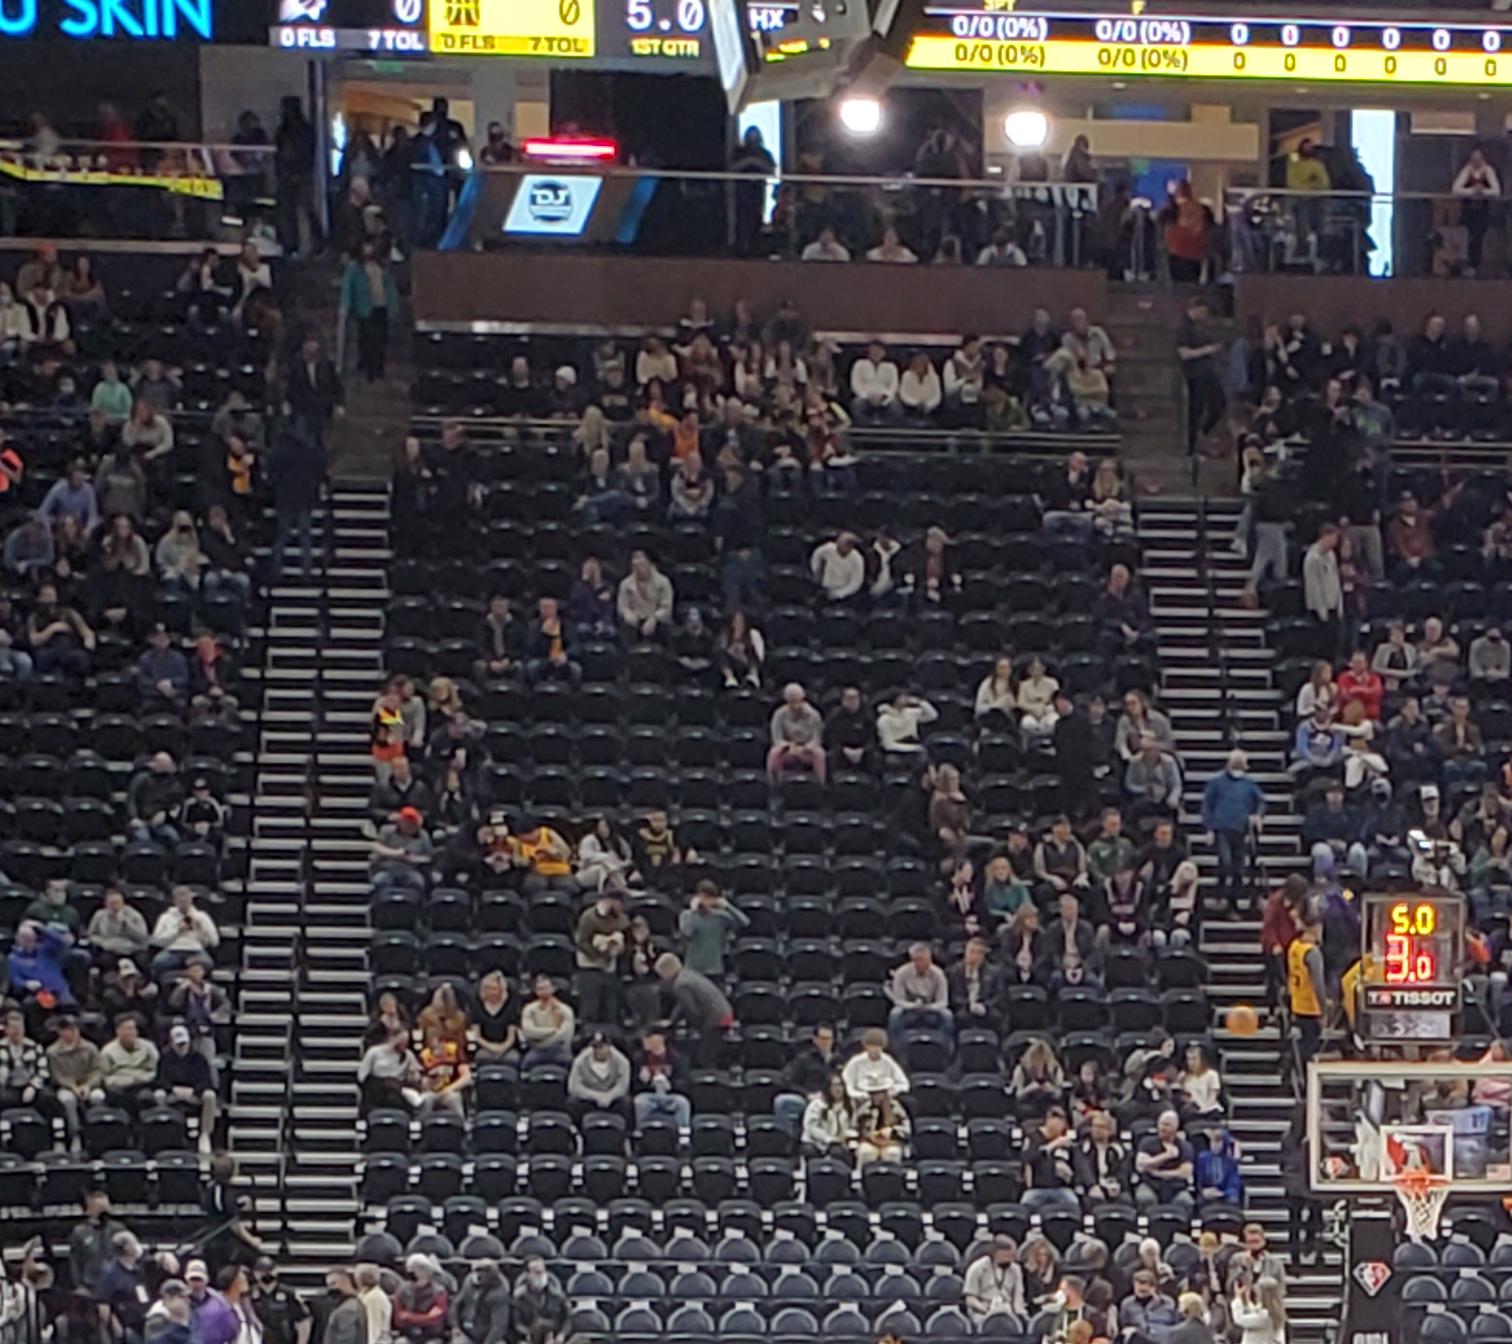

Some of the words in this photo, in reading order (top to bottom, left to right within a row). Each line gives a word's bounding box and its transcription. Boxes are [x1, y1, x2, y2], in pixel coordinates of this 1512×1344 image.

[60, 0, 212, 38] SKIN
[628, 0, 704, 31] 5.0
[1231, 24, 1248, 45] 0
[1281, 25, 1299, 46] 0
[1332, 26, 1350, 48] 0
[1382, 28, 1400, 50] 0
[1433, 29, 1451, 51] 0
[1483, 31, 1500, 52] 0
[1233, 51, 1246, 70] 0
[1284, 52, 1296, 71] 0
[1334, 54, 1347, 72] 0
[1384, 56, 1396, 74] 0
[1435, 57, 1447, 75] 0
[1484, 59, 1497, 77] 0
[1392, 904, 1435, 935] 5.0
[1392, 990, 1456, 1005] TISSOT
